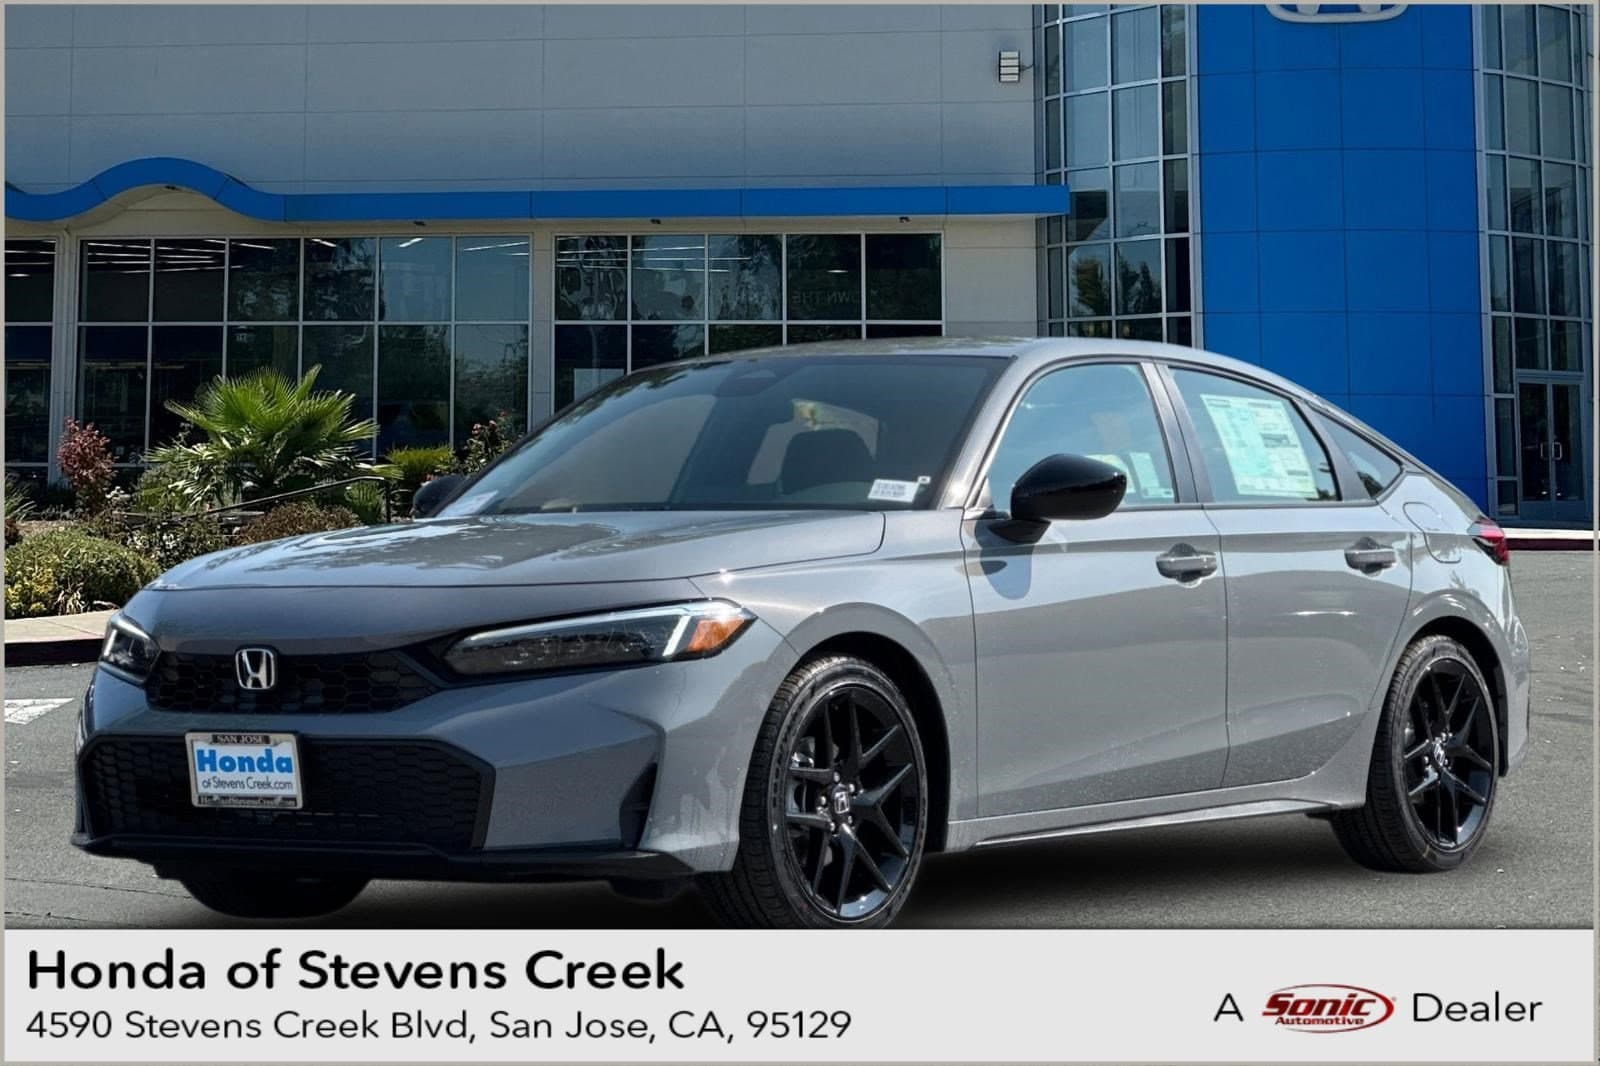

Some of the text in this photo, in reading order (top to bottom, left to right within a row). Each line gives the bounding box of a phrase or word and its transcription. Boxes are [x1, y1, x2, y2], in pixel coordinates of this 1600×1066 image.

[196, 748, 293, 773] Honda
[212, 776, 245, 789] Stevens
[246, 776, 293, 790] Creek.com
